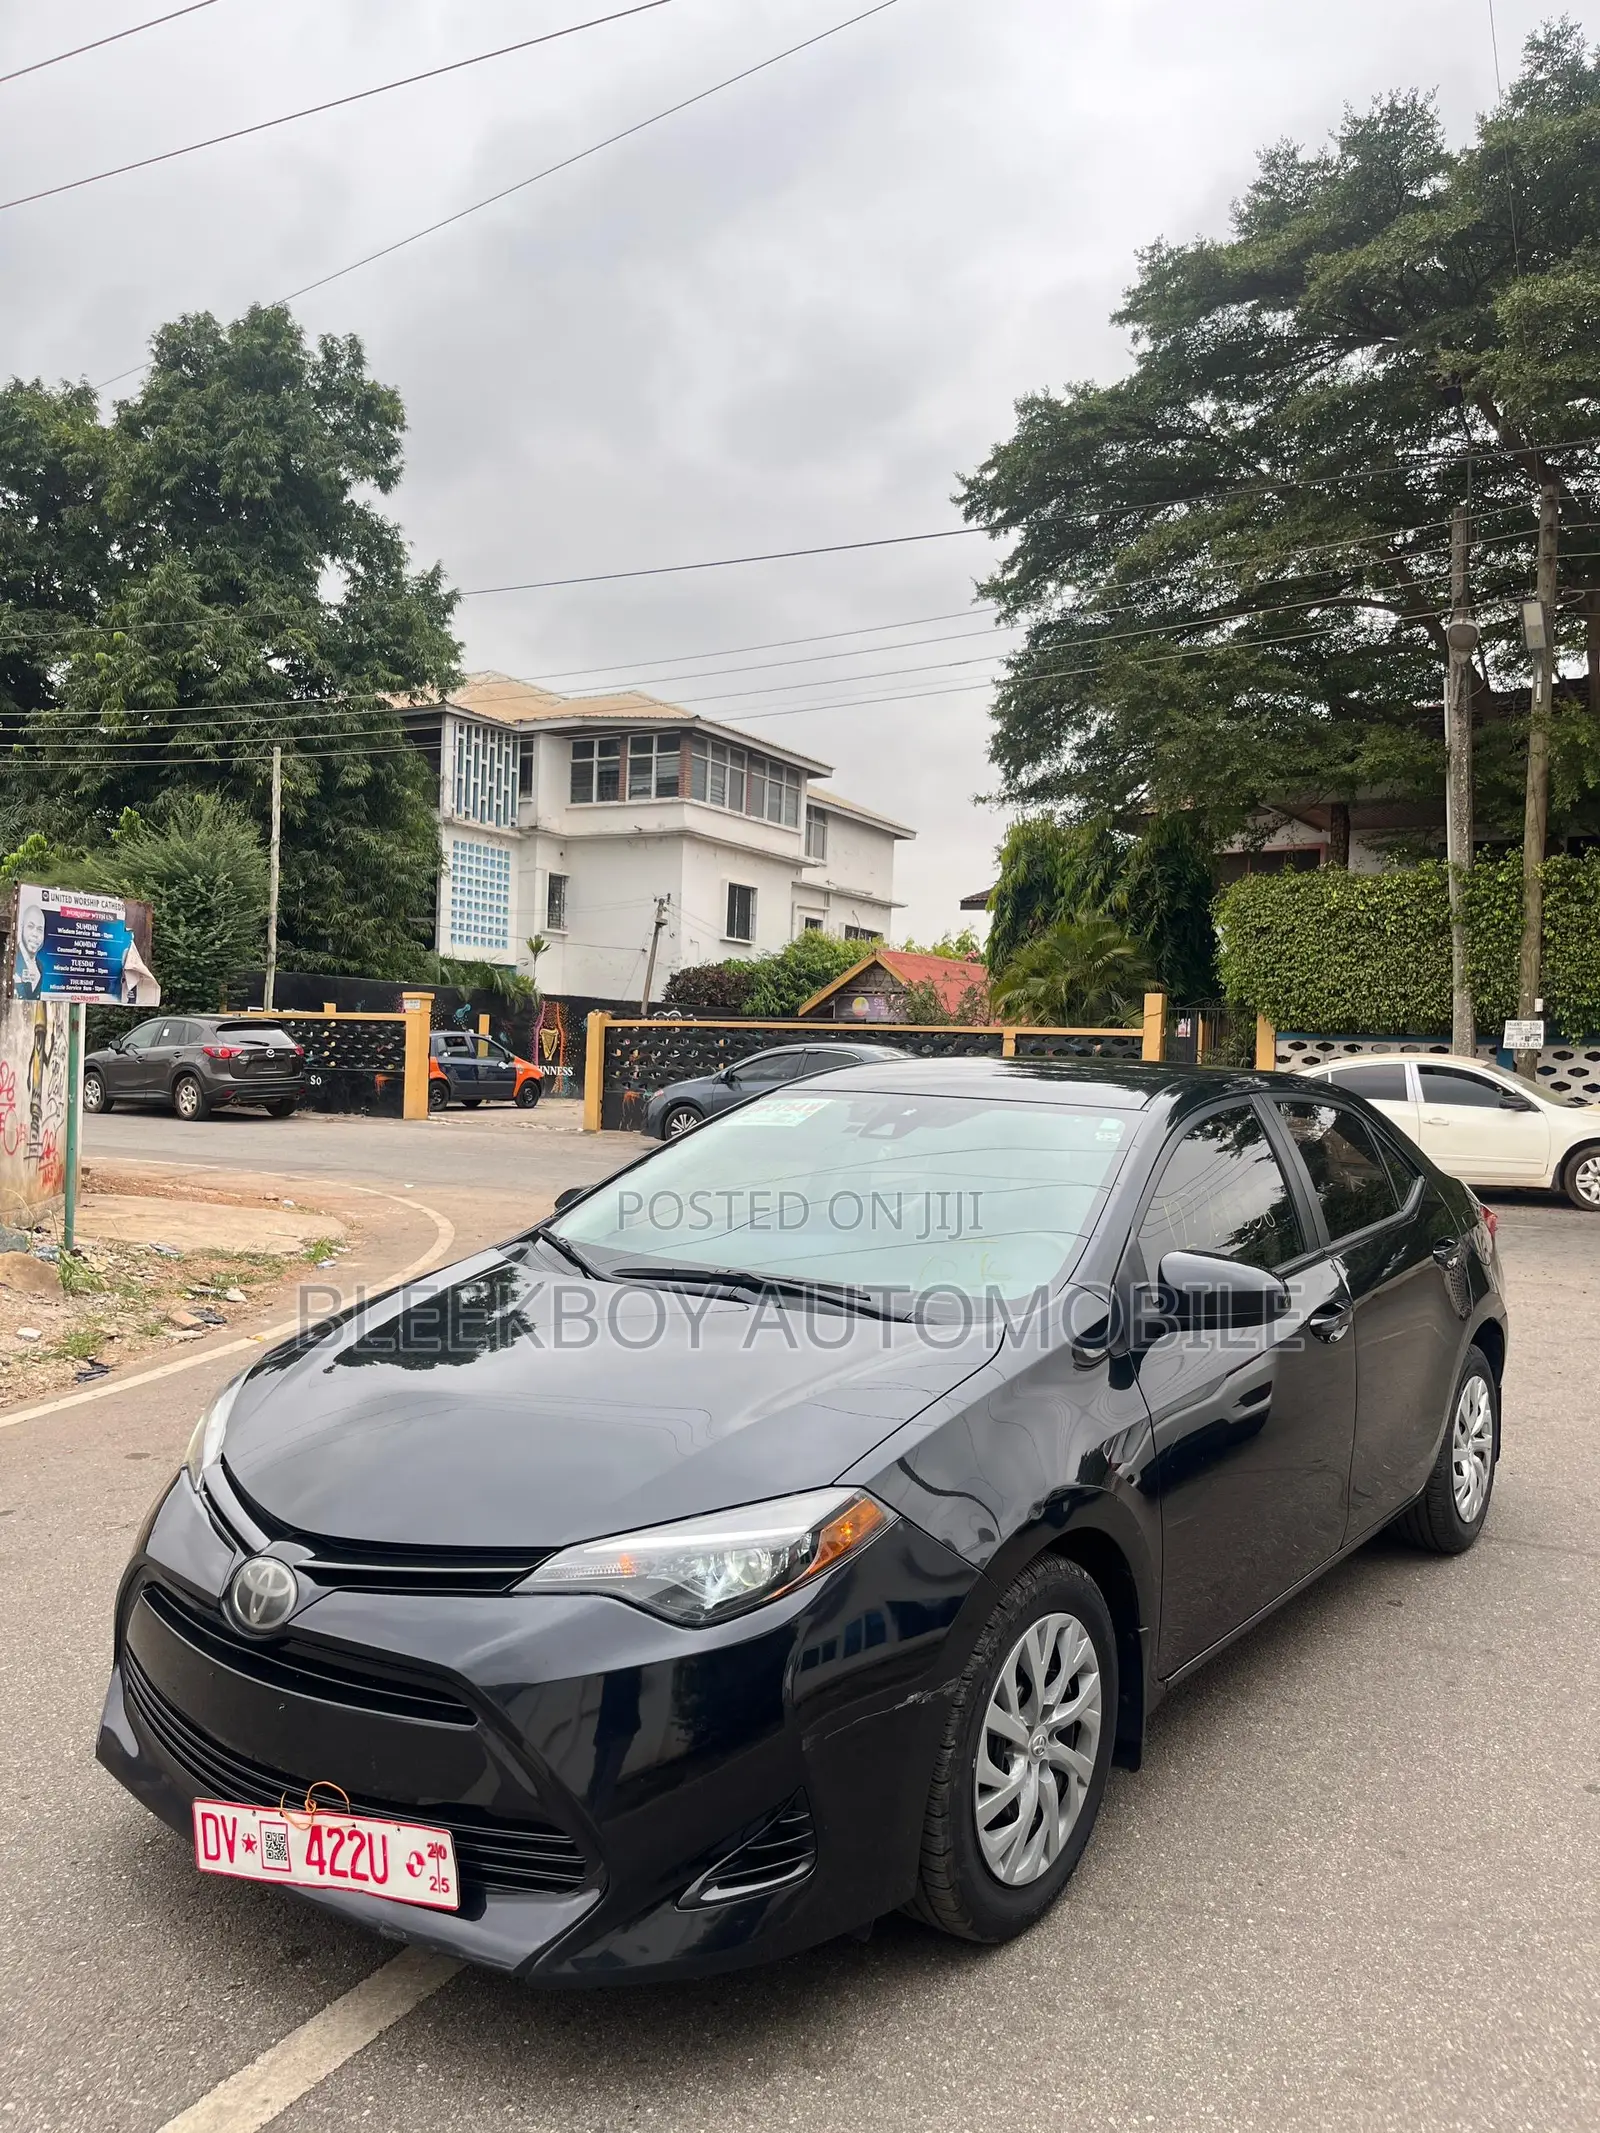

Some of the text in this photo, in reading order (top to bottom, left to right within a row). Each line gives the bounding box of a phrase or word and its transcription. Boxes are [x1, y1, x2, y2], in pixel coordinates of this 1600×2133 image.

[51, 893, 72, 904] UNITED
[74, 895, 100, 907] WORSHIP
[57, 927, 75, 935] Wisdom
[75, 929, 91, 937] Service
[75, 922, 99, 931] SUNDAY
[74, 940, 97, 948] MONDAY
[53, 964, 69, 972] Miracle
[71, 959, 95, 967] TUESDAY
[538, 1065, 574, 1077] INNESS
[201, 1812, 389, 1884] DV 422U
[427, 1842, 448, 1860] 20
[429, 1876, 450, 1893] 25
